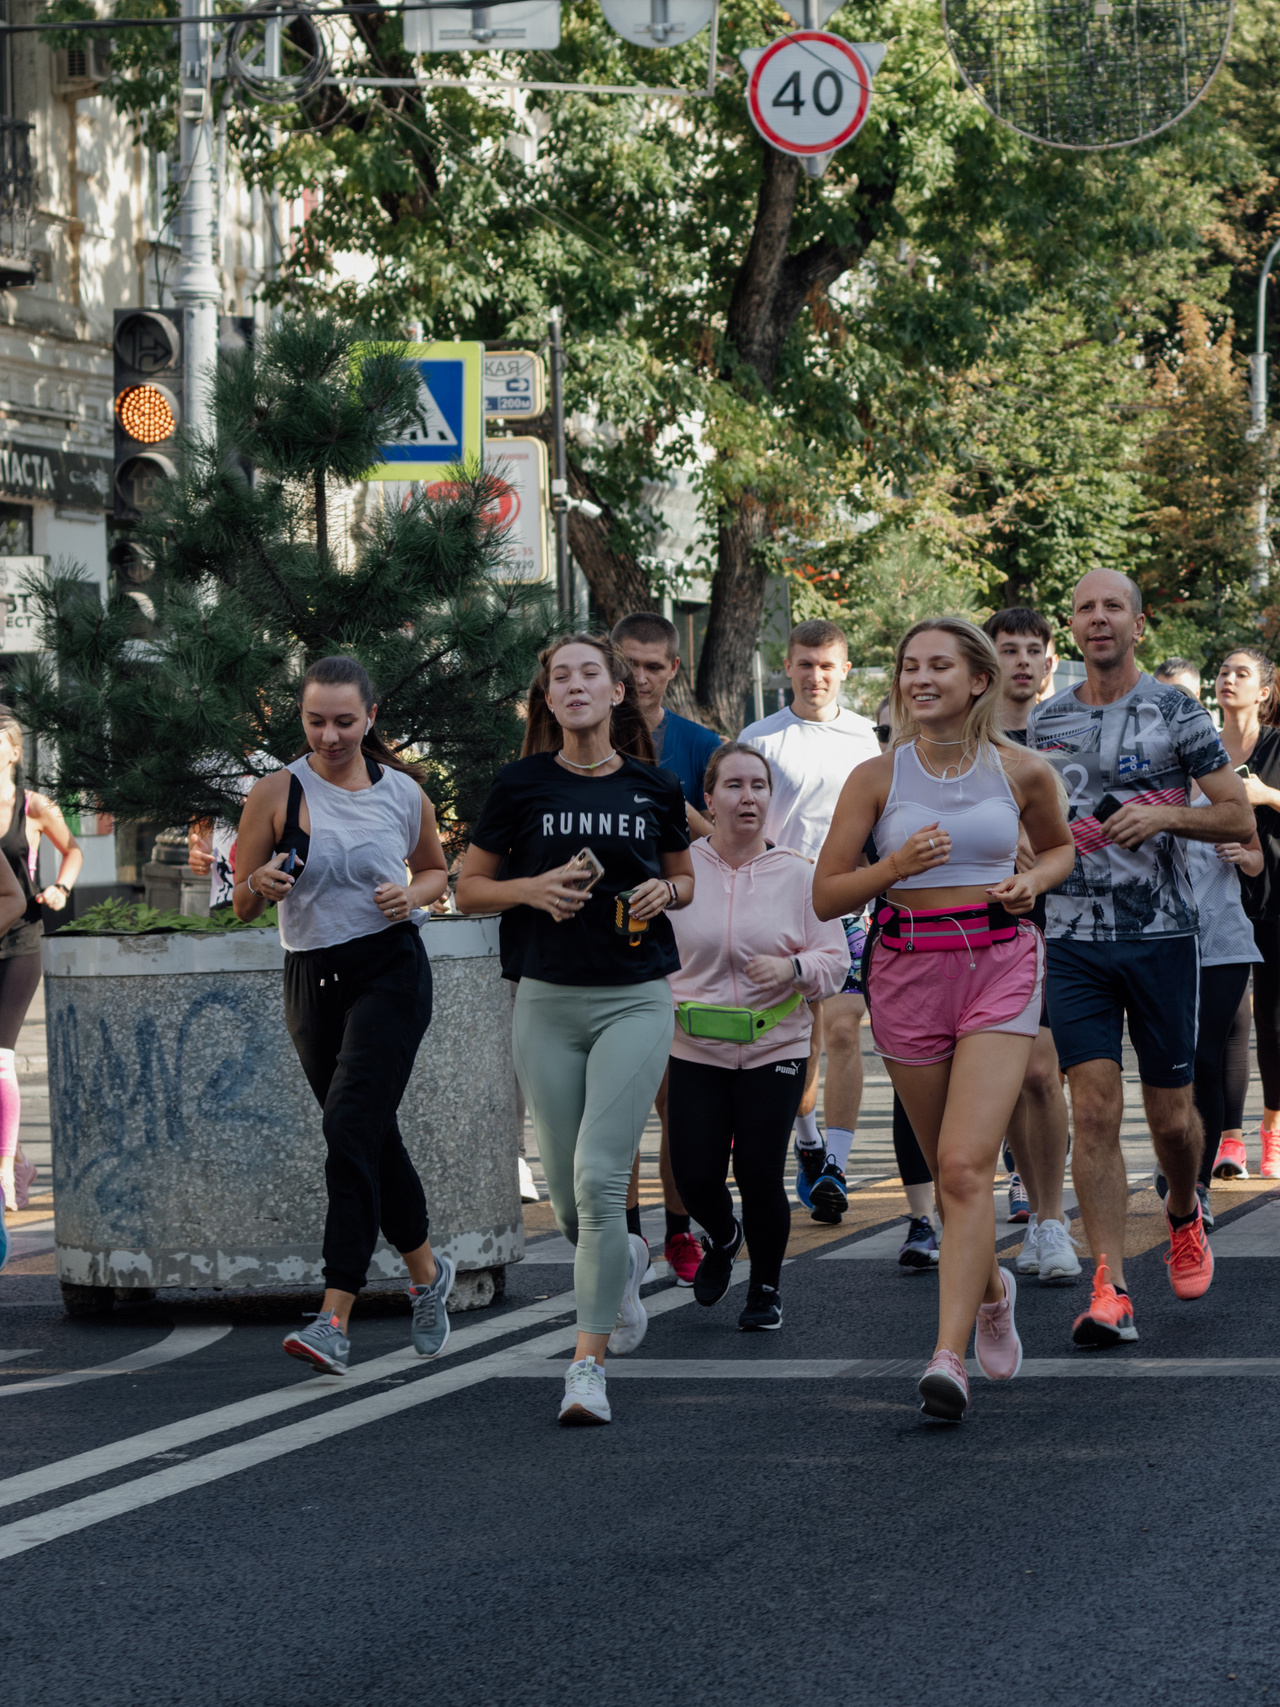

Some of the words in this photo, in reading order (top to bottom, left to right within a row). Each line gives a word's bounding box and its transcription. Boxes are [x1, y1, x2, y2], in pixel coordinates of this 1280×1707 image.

[772, 69, 843, 116] 40
[501, 398, 530, 409] 200м
[542, 812, 646, 840] RUNNER
